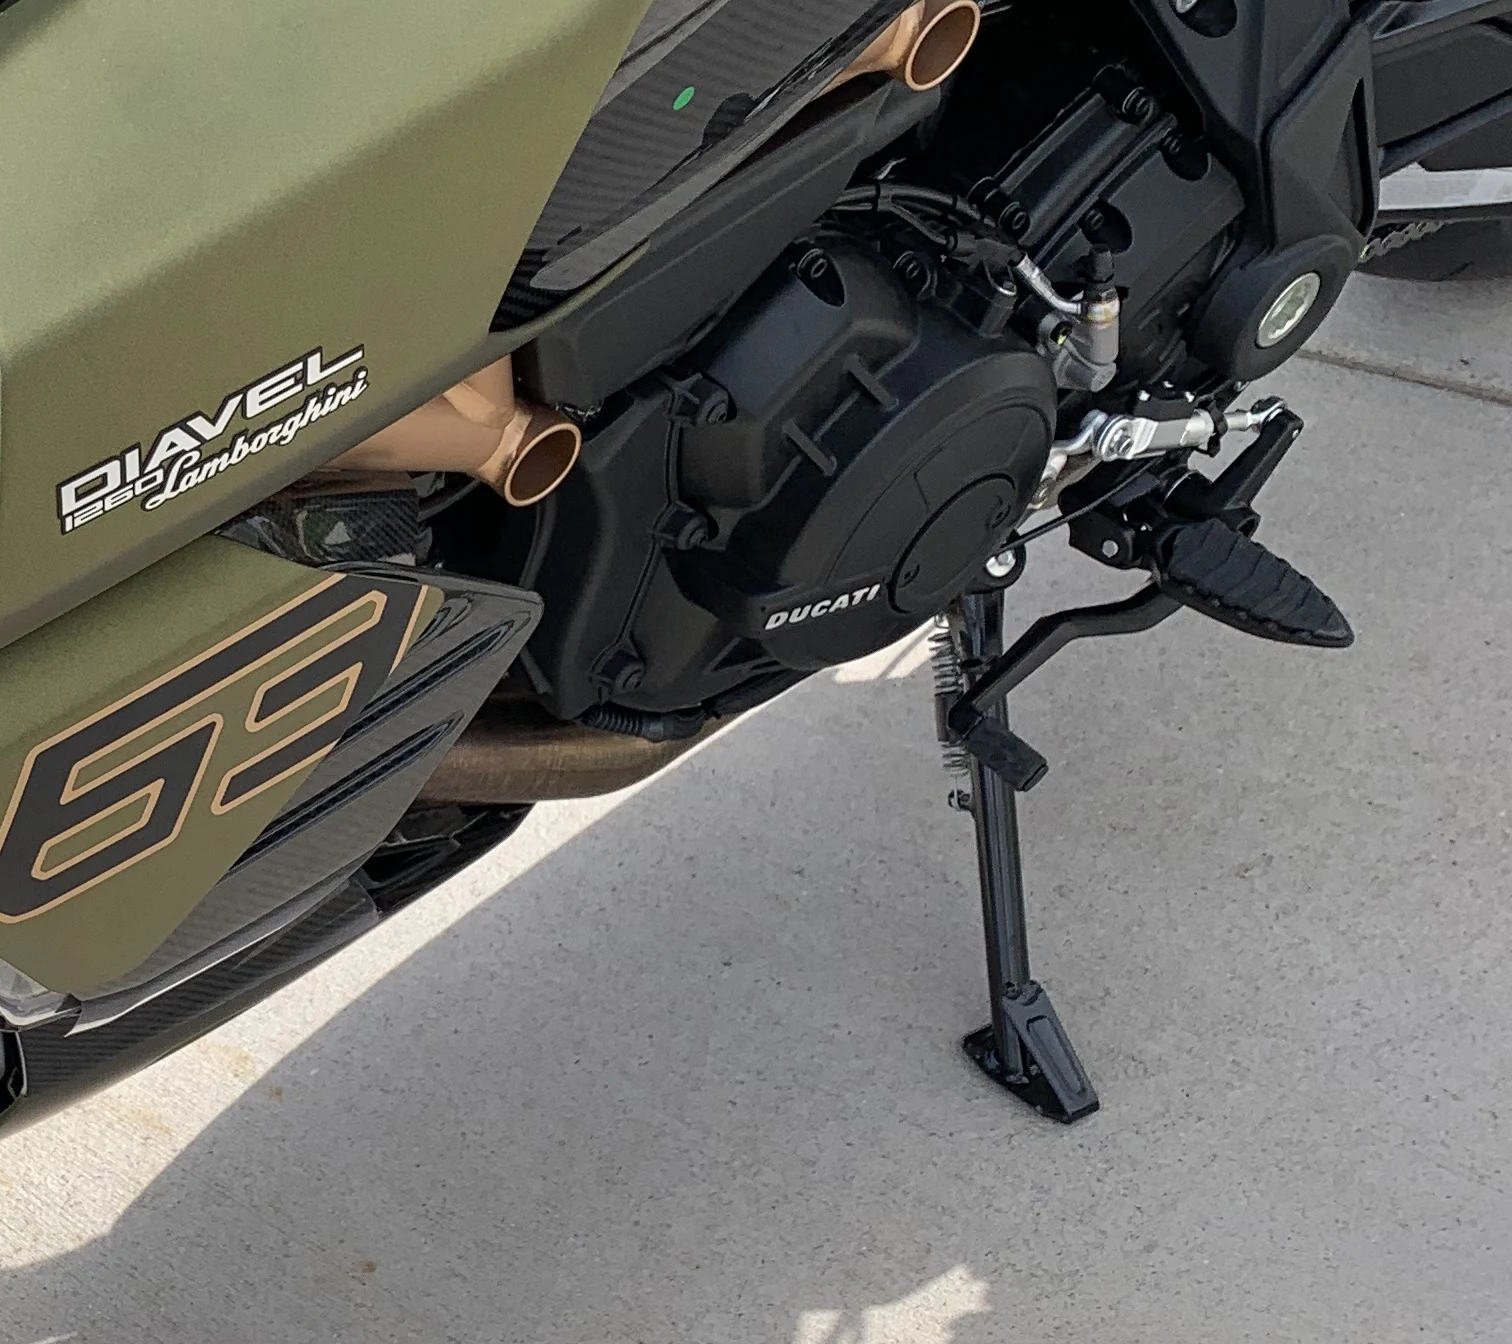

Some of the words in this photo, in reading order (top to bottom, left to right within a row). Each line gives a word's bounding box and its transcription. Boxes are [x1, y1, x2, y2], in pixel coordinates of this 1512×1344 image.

[58, 346, 364, 517] DIAVEL
[63, 468, 164, 533] 1260
[143, 368, 369, 511] Lamborghini
[764, 583, 881, 631] DUCATI
